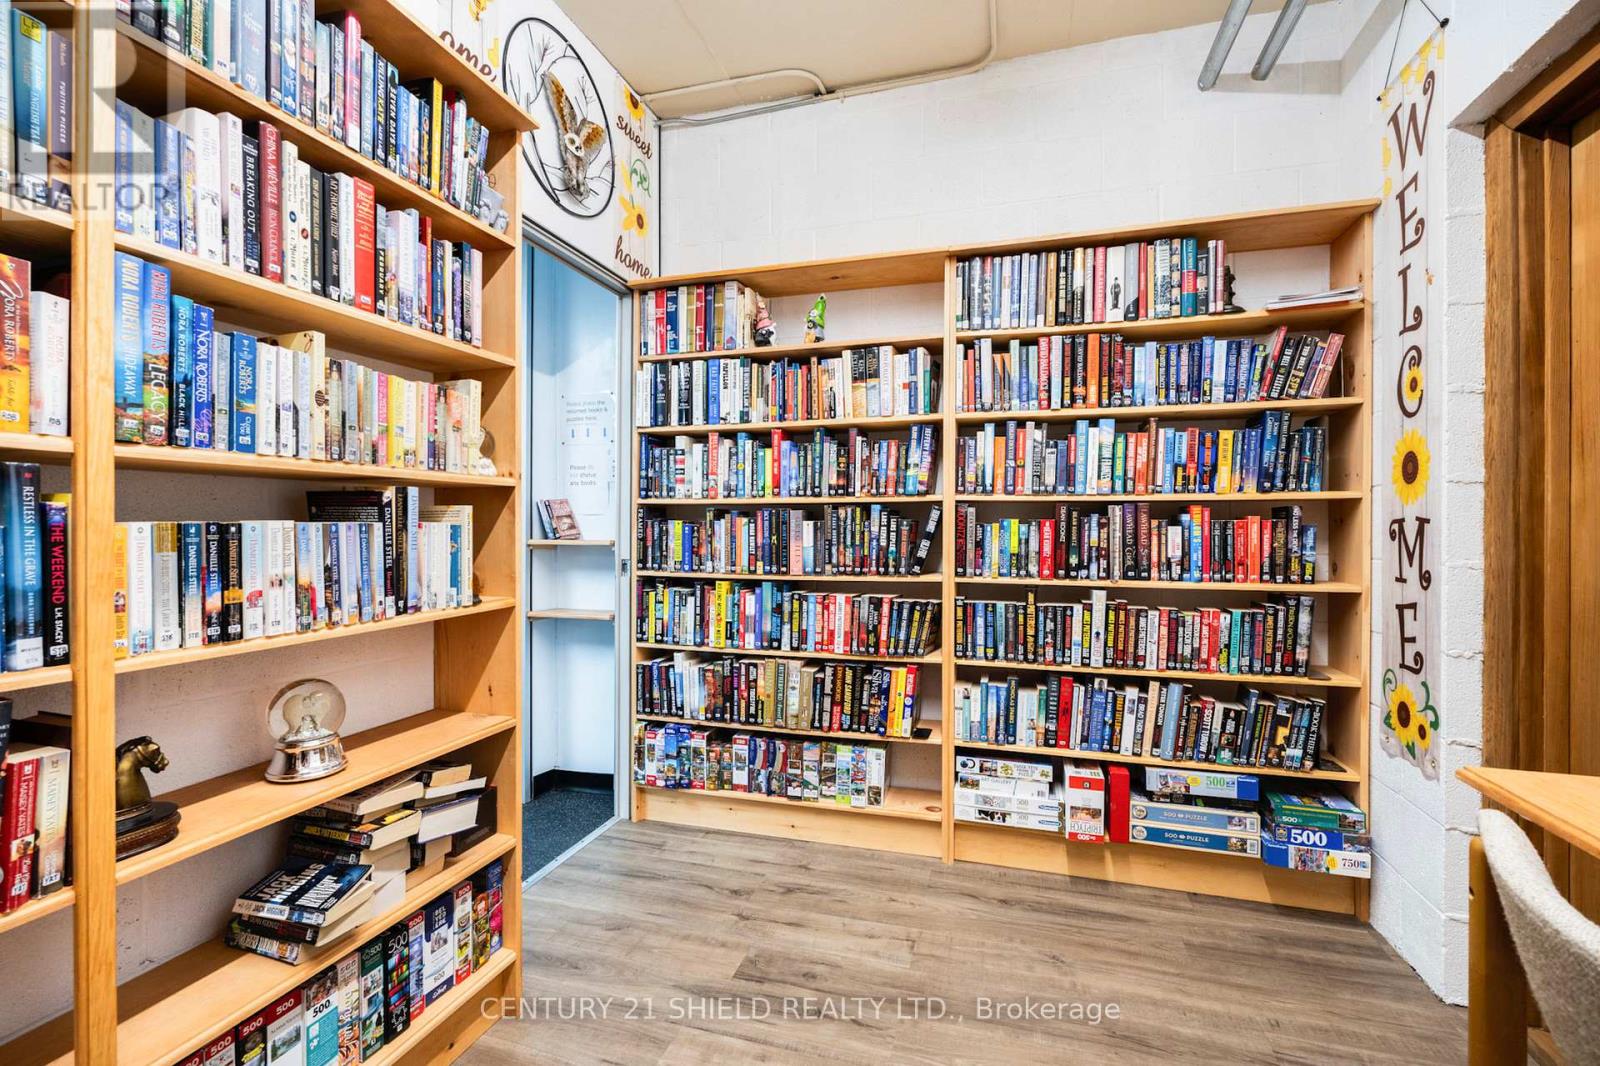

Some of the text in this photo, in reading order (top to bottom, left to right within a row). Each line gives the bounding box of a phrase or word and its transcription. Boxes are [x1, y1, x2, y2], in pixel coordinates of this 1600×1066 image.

[266, 128, 277, 161] CHINA
[616, 115, 652, 160] sweet
[246, 155, 256, 233] BREAKING OUT
[615, 235, 652, 279] home
[121, 259, 139, 290] NORA
[121, 293, 139, 345] ROBERTS
[178, 306, 187, 330] NORA
[4, 320, 16, 361] ROBERTS
[149, 270, 169, 421] NORA ROBERTS LEGACY
[178, 334, 186, 372] ROBERTS
[196, 329, 210, 359] NORA
[196, 362, 209, 402] ROBERTS
[922, 428, 932, 450] JEFFERY
[22, 486, 35, 585] RESTLESS IN THE GRAVE
[51, 522, 65, 604] THE WEEKEND
[189, 545, 197, 576] DANIELLE
[54, 620, 63, 644] STACEY
[1083, 610, 1091, 624] JAMES
[870, 669, 881, 693] Silva
[882, 672, 890, 688] Silva
[844, 684, 852, 714] SANDFORD
[1135, 703, 1145, 734] BRAD THOR
[1199, 709, 1211, 753] SCOTT TUROW
[1306, 712, 1320, 754] BOOK THIEF
[1206, 776, 1225, 787] 500
[17, 812, 26, 838] YATES
[1291, 829, 1327, 846] 500
[1342, 858, 1360, 868] 750
[388, 931, 408, 954] 500
[276, 998, 295, 1015] 500
[312, 999, 331, 1018] 500
[242, 1017, 264, 1036] 500
